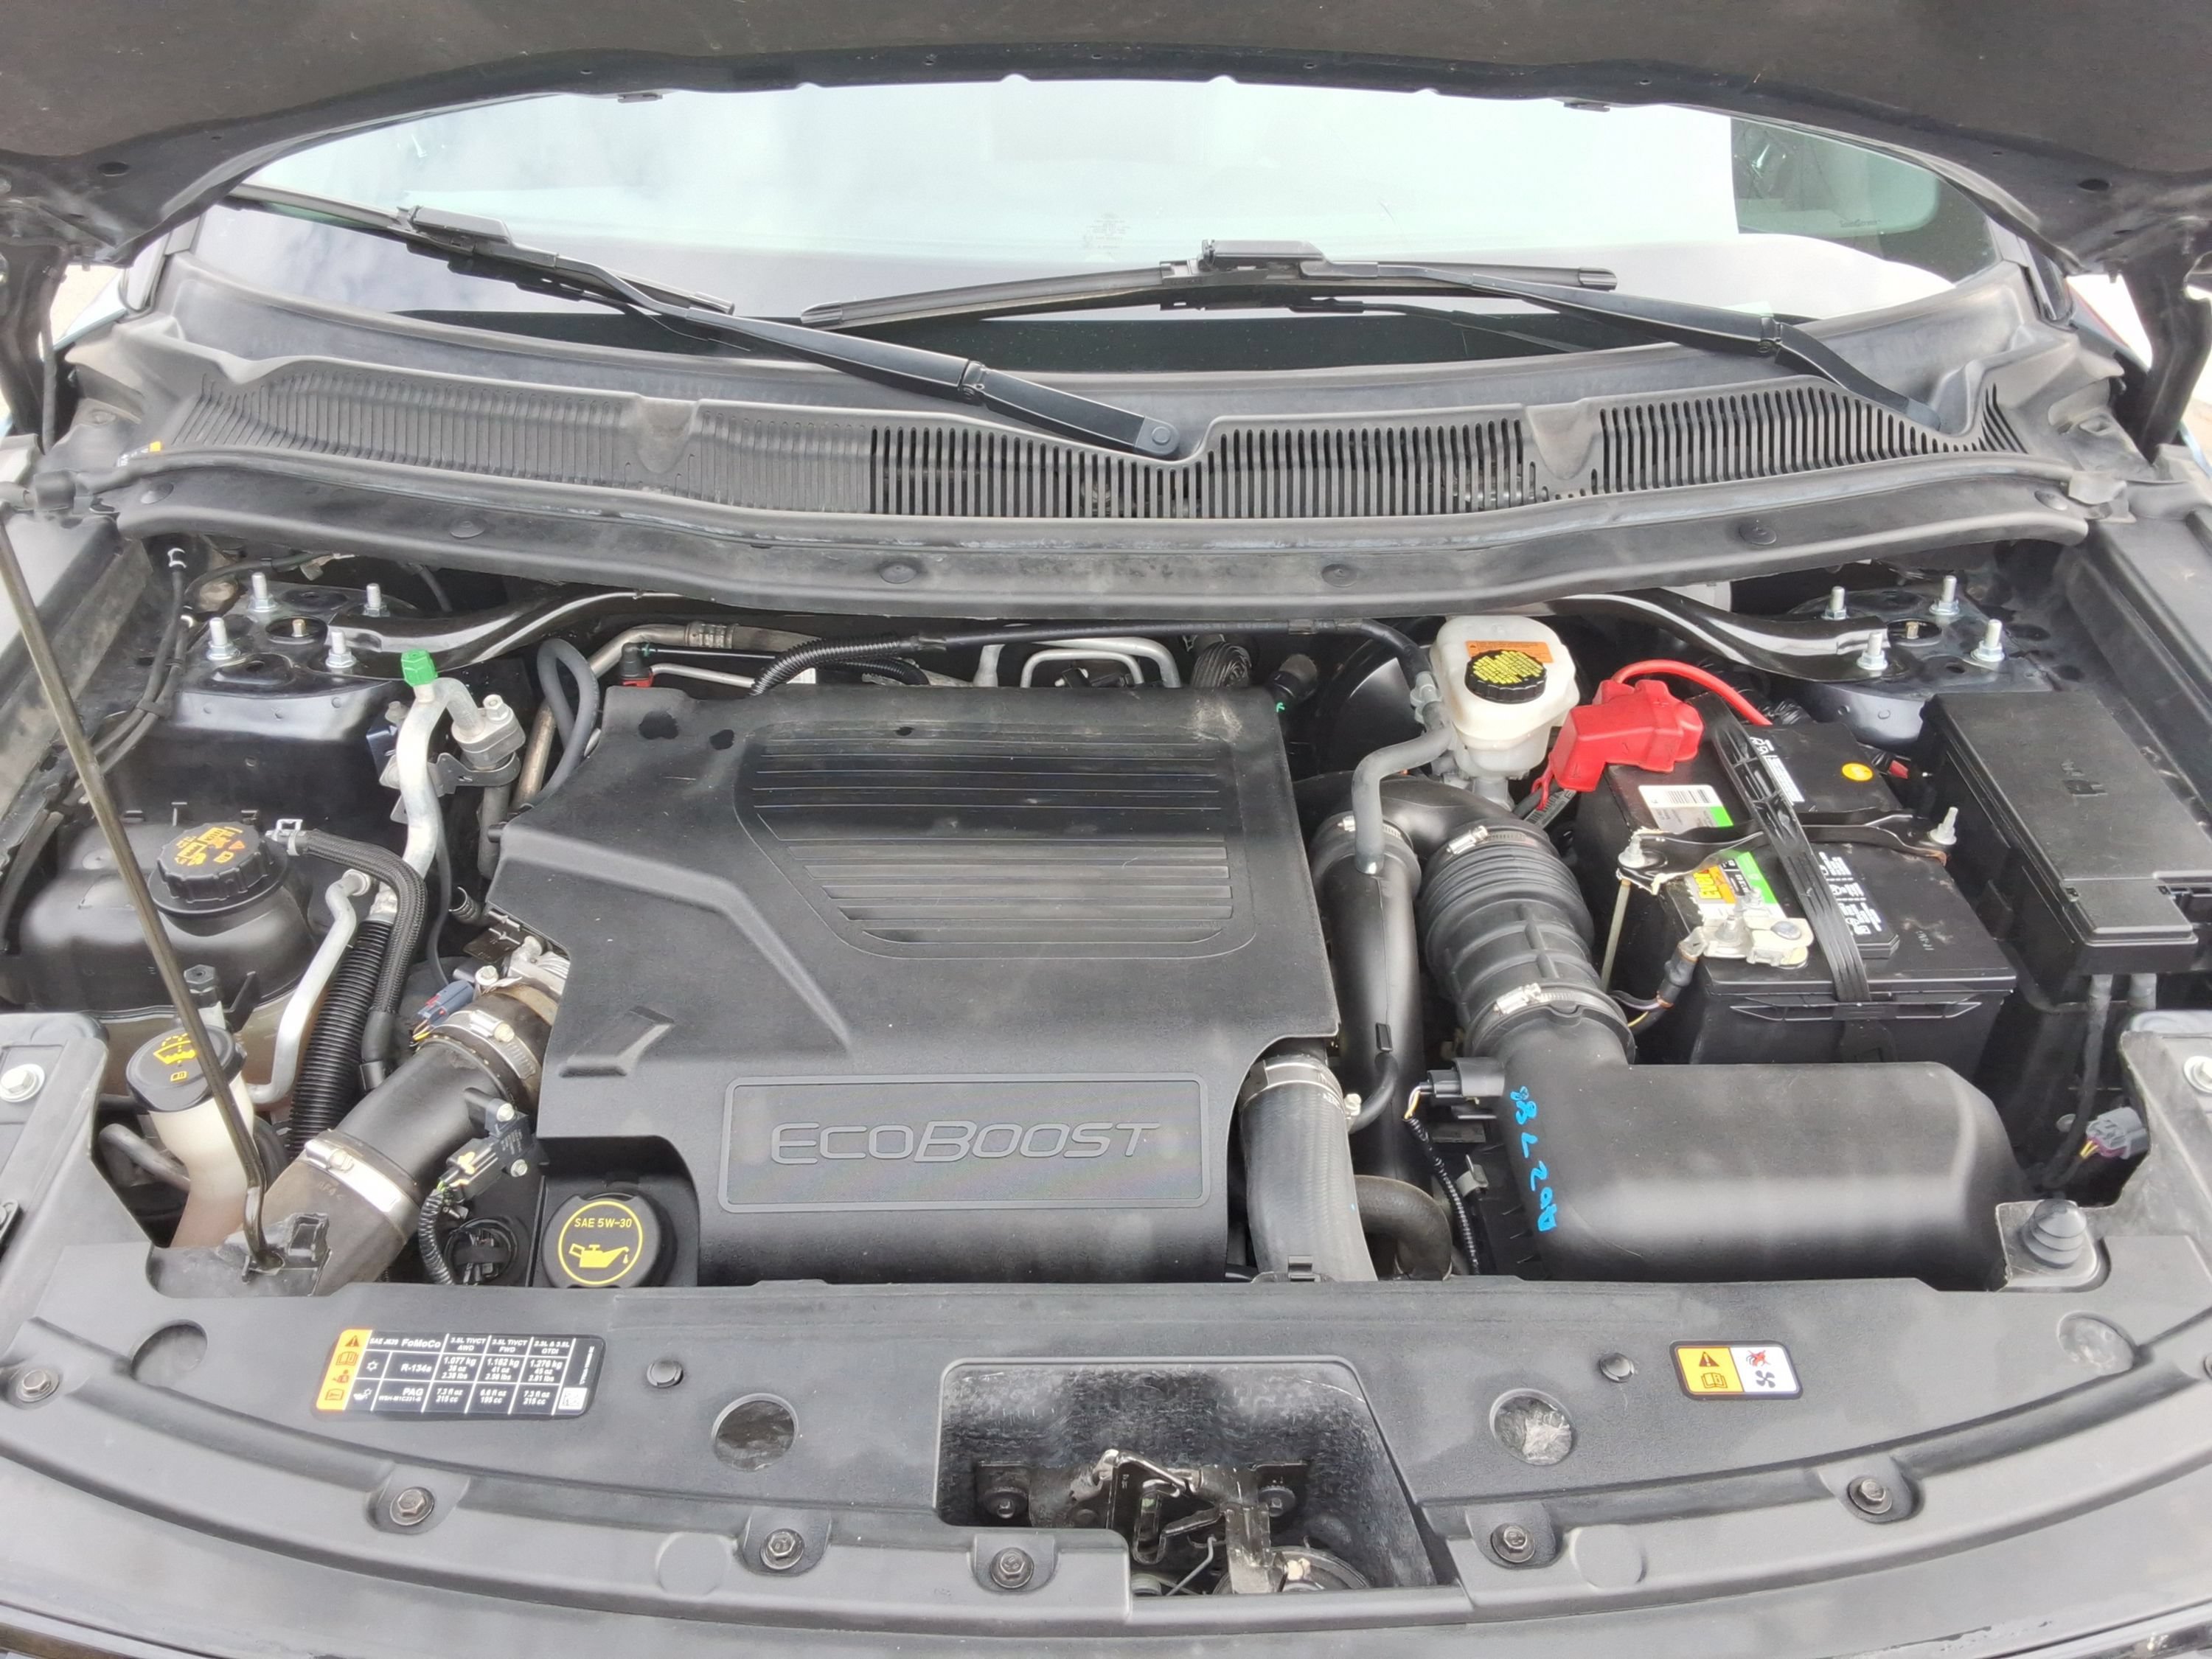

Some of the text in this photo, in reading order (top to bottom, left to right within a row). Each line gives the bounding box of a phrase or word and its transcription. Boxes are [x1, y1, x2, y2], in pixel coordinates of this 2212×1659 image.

[574, 1218, 633, 1228] SAE 5W-30
[401, 1338, 442, 1348] FoMoCo
[444, 1357, 477, 1367] 1.077 kg
[509, 1358, 521, 1368] kg
[552, 1360, 563, 1370] kg
[400, 1363, 433, 1373] R-134a
[402, 1388, 425, 1397] PAG
